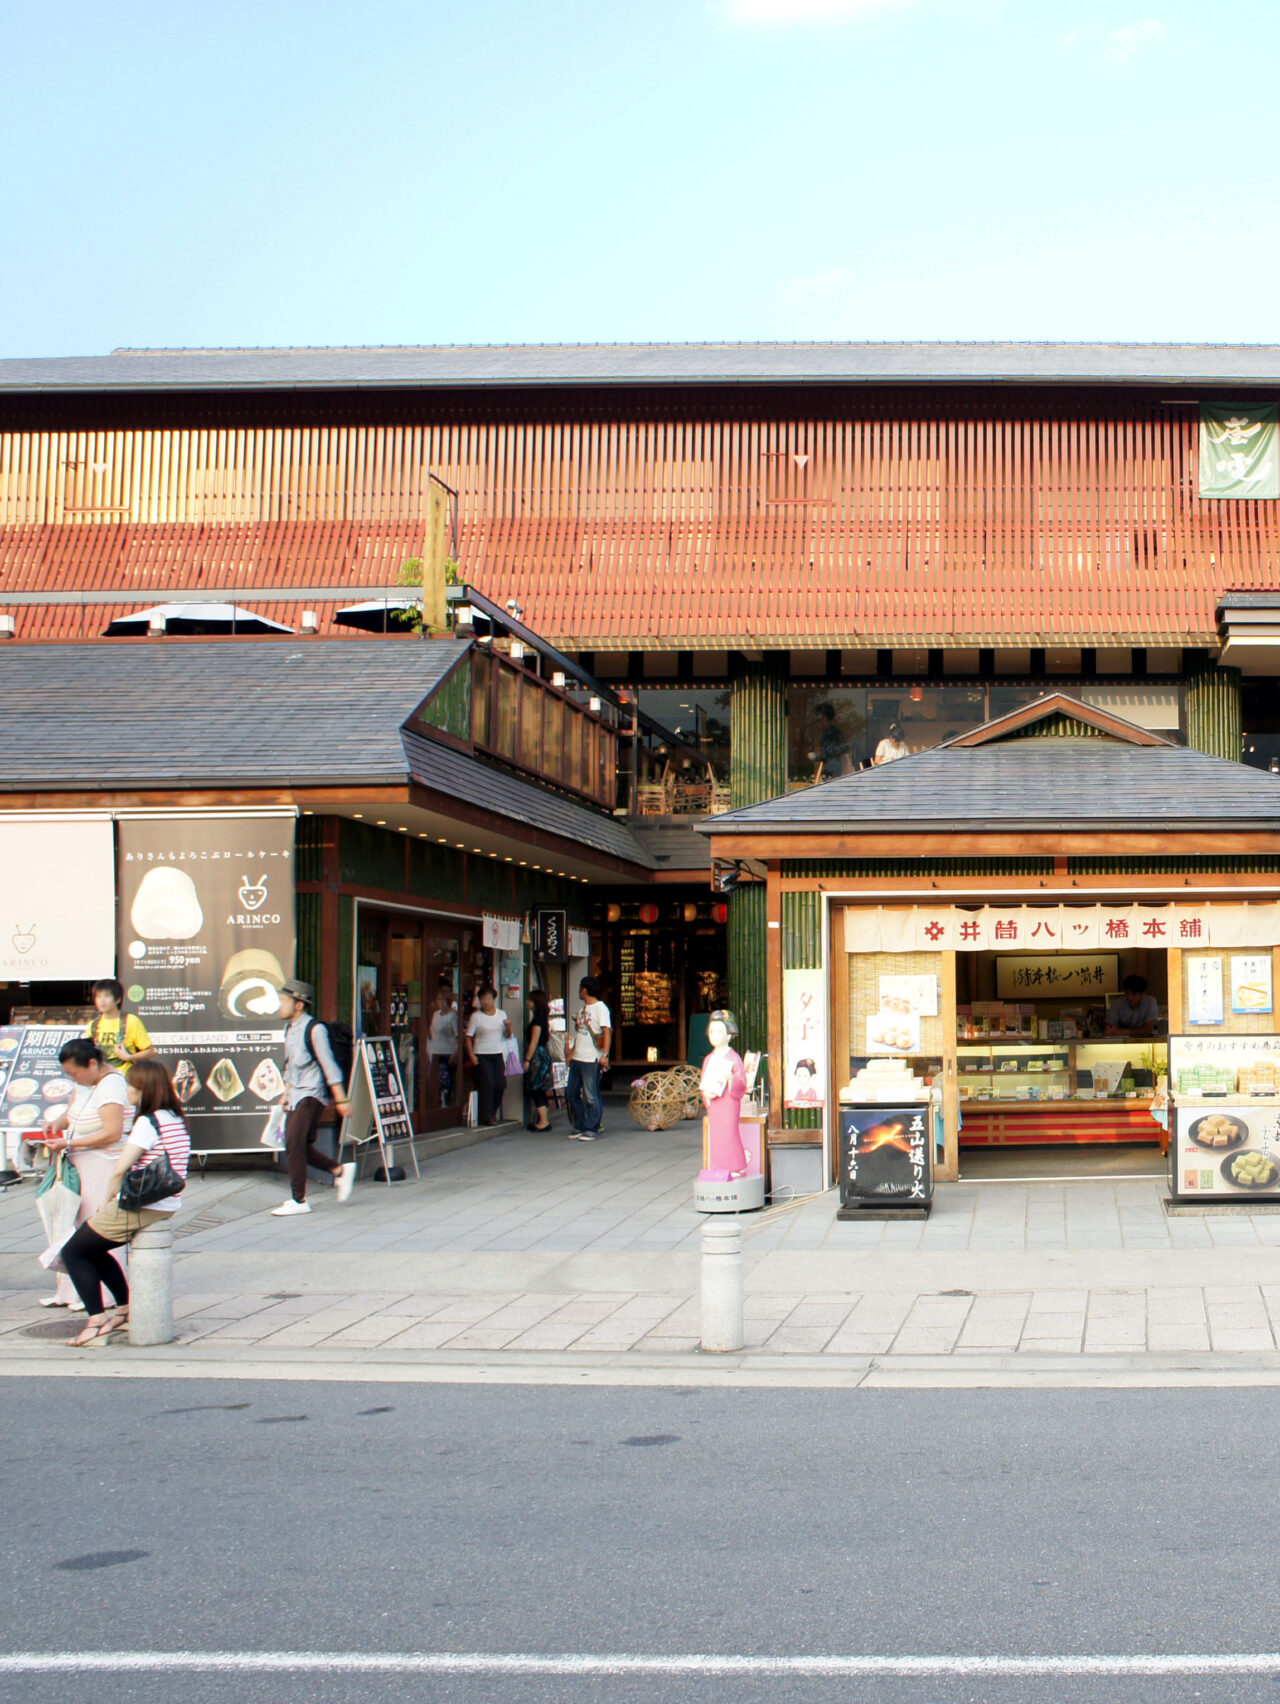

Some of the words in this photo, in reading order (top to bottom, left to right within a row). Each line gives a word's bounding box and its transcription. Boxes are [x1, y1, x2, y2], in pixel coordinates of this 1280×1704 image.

[226, 914, 281, 925] ARINCO
[1, 959, 49, 969] ARINCO
[169, 956, 185, 964] 950
[185, 957, 201, 967] yen
[174, 1001, 189, 1010] 950
[189, 1003, 205, 1013] yen
[797, 991, 815, 1041] 夕子
[24, 1031, 86, 1047] 期間限
[21, 1047, 57, 1055] ARINCO
[847, 1124, 860, 1181] 八月十六日
[907, 1114, 926, 1199] 五山送り火
